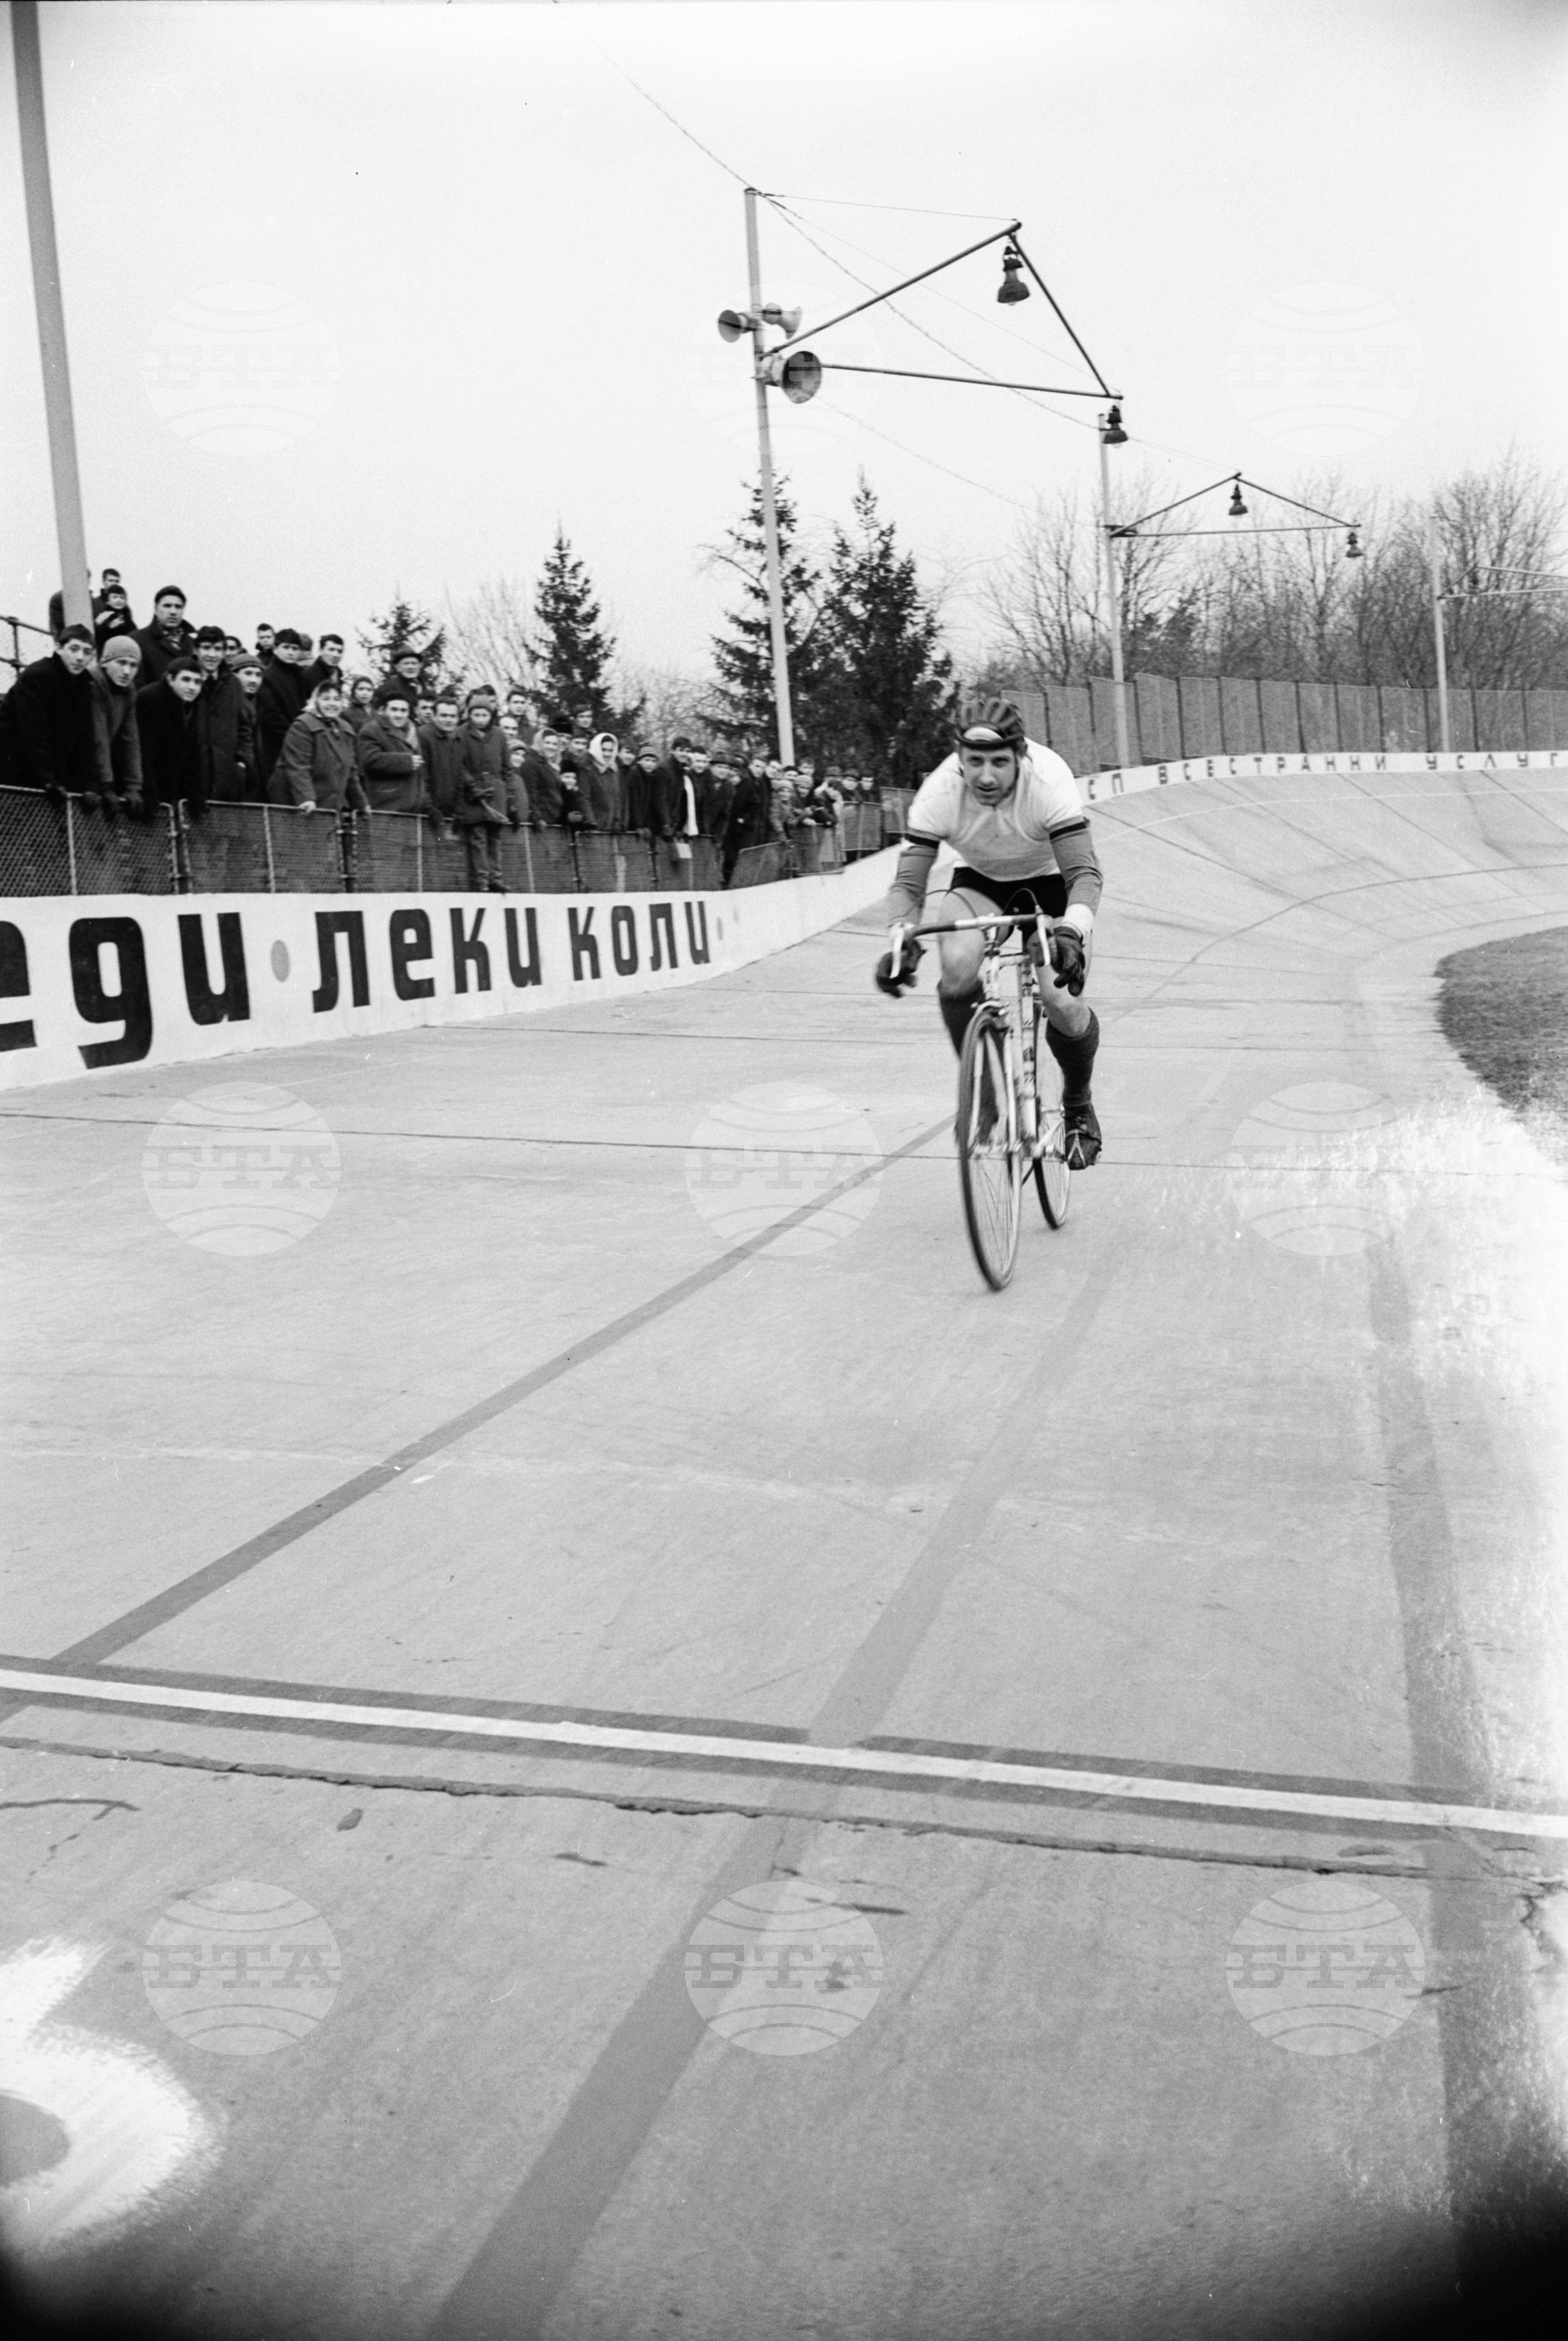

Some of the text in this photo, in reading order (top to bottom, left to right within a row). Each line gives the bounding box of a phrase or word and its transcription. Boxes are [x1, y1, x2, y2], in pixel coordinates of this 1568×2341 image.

[1158, 755, 1388, 785] ВСЕСТРАННИ
[312, 908, 544, 1014] леки
[567, 901, 711, 981] коли
